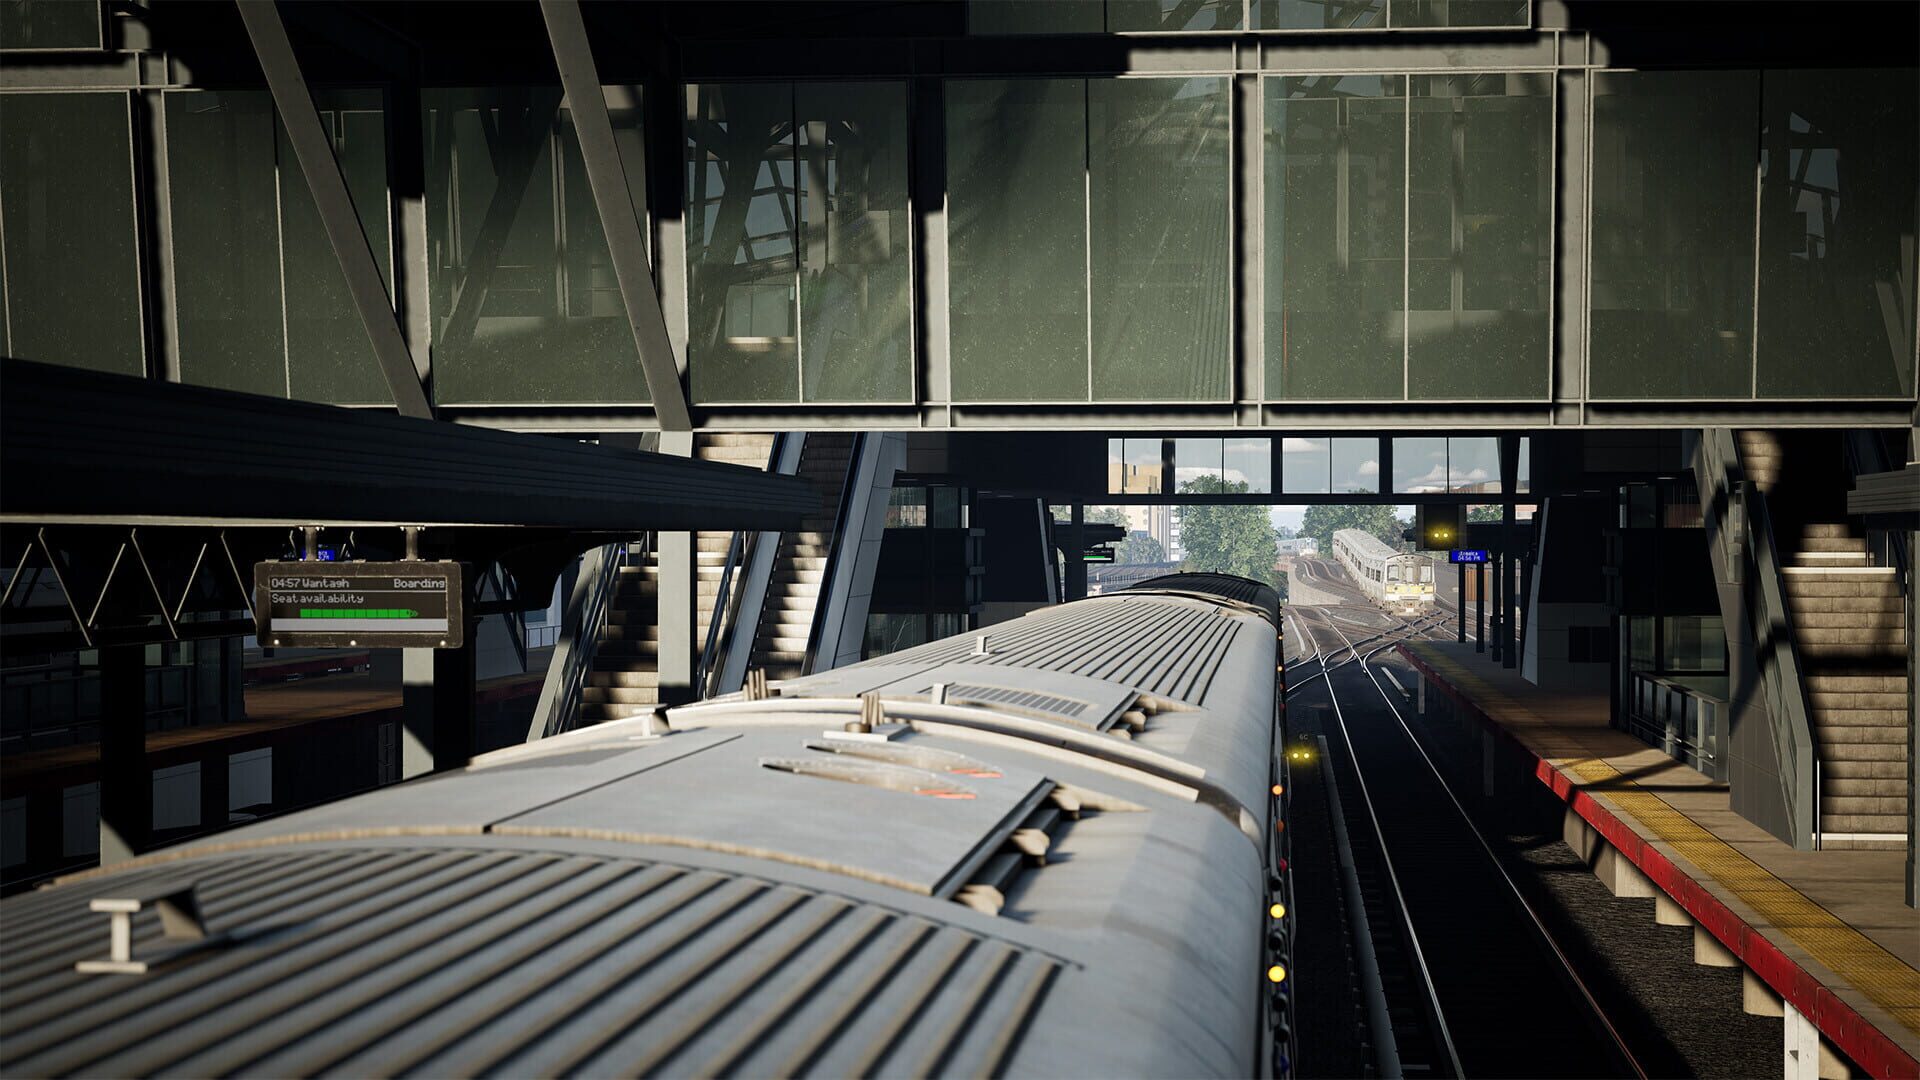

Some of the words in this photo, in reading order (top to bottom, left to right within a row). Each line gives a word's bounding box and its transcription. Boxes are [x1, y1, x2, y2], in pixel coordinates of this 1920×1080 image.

[271, 577, 301, 589] 04:57
[302, 577, 350, 589] Wantagh
[393, 577, 445, 589] Boarding
[271, 593, 299, 604] Seat
[300, 593, 364, 605] availability
